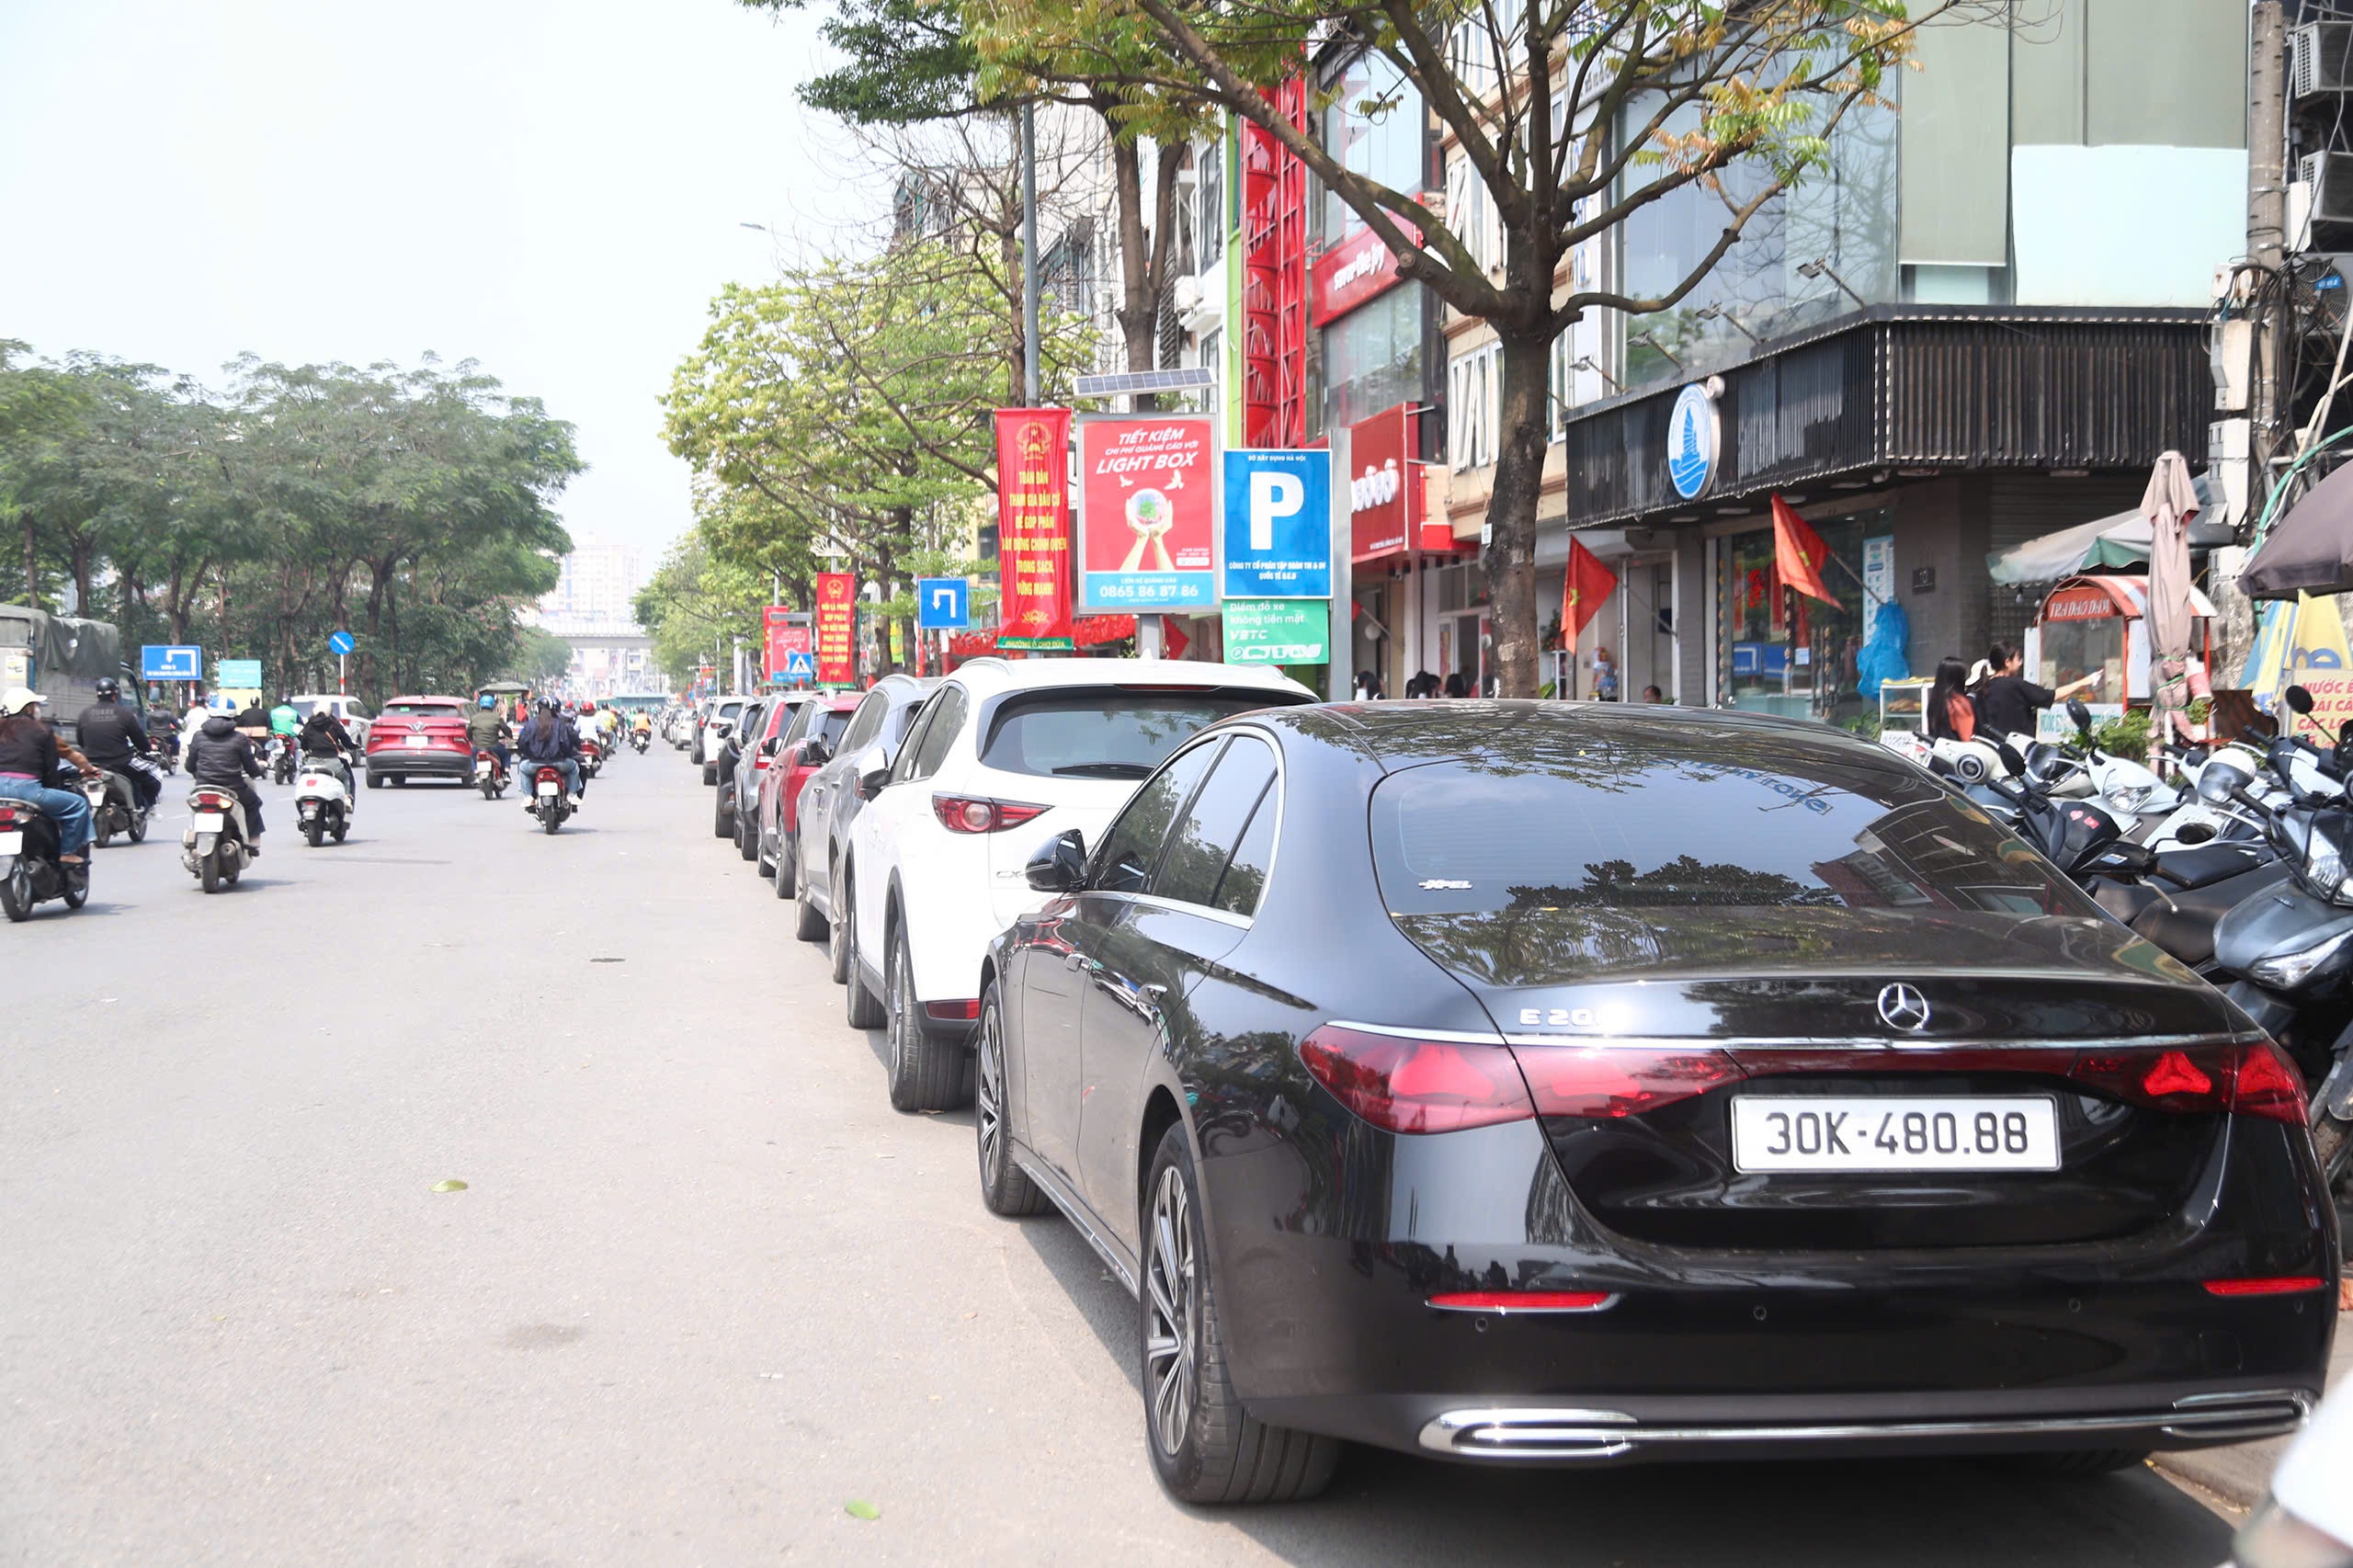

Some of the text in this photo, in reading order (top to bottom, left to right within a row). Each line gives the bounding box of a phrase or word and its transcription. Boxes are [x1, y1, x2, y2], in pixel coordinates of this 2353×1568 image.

[1119, 426, 1185, 445] TIẾT KIỆM
[1105, 439, 1199, 456] CHI PHÍ QUẢNG CÁO VỚI
[1096, 451, 1199, 474] LIGHT BOX
[1027, 494, 1038, 506] GIA
[1250, 472, 1304, 551] P
[1099, 585, 1199, 597] 0865 86 87 86
[1273, 603, 1285, 611] xe
[1229, 630, 1267, 641] VETC
[1519, 1008, 1542, 1027] E
[1766, 1111, 2028, 1154] 30K-480.88
